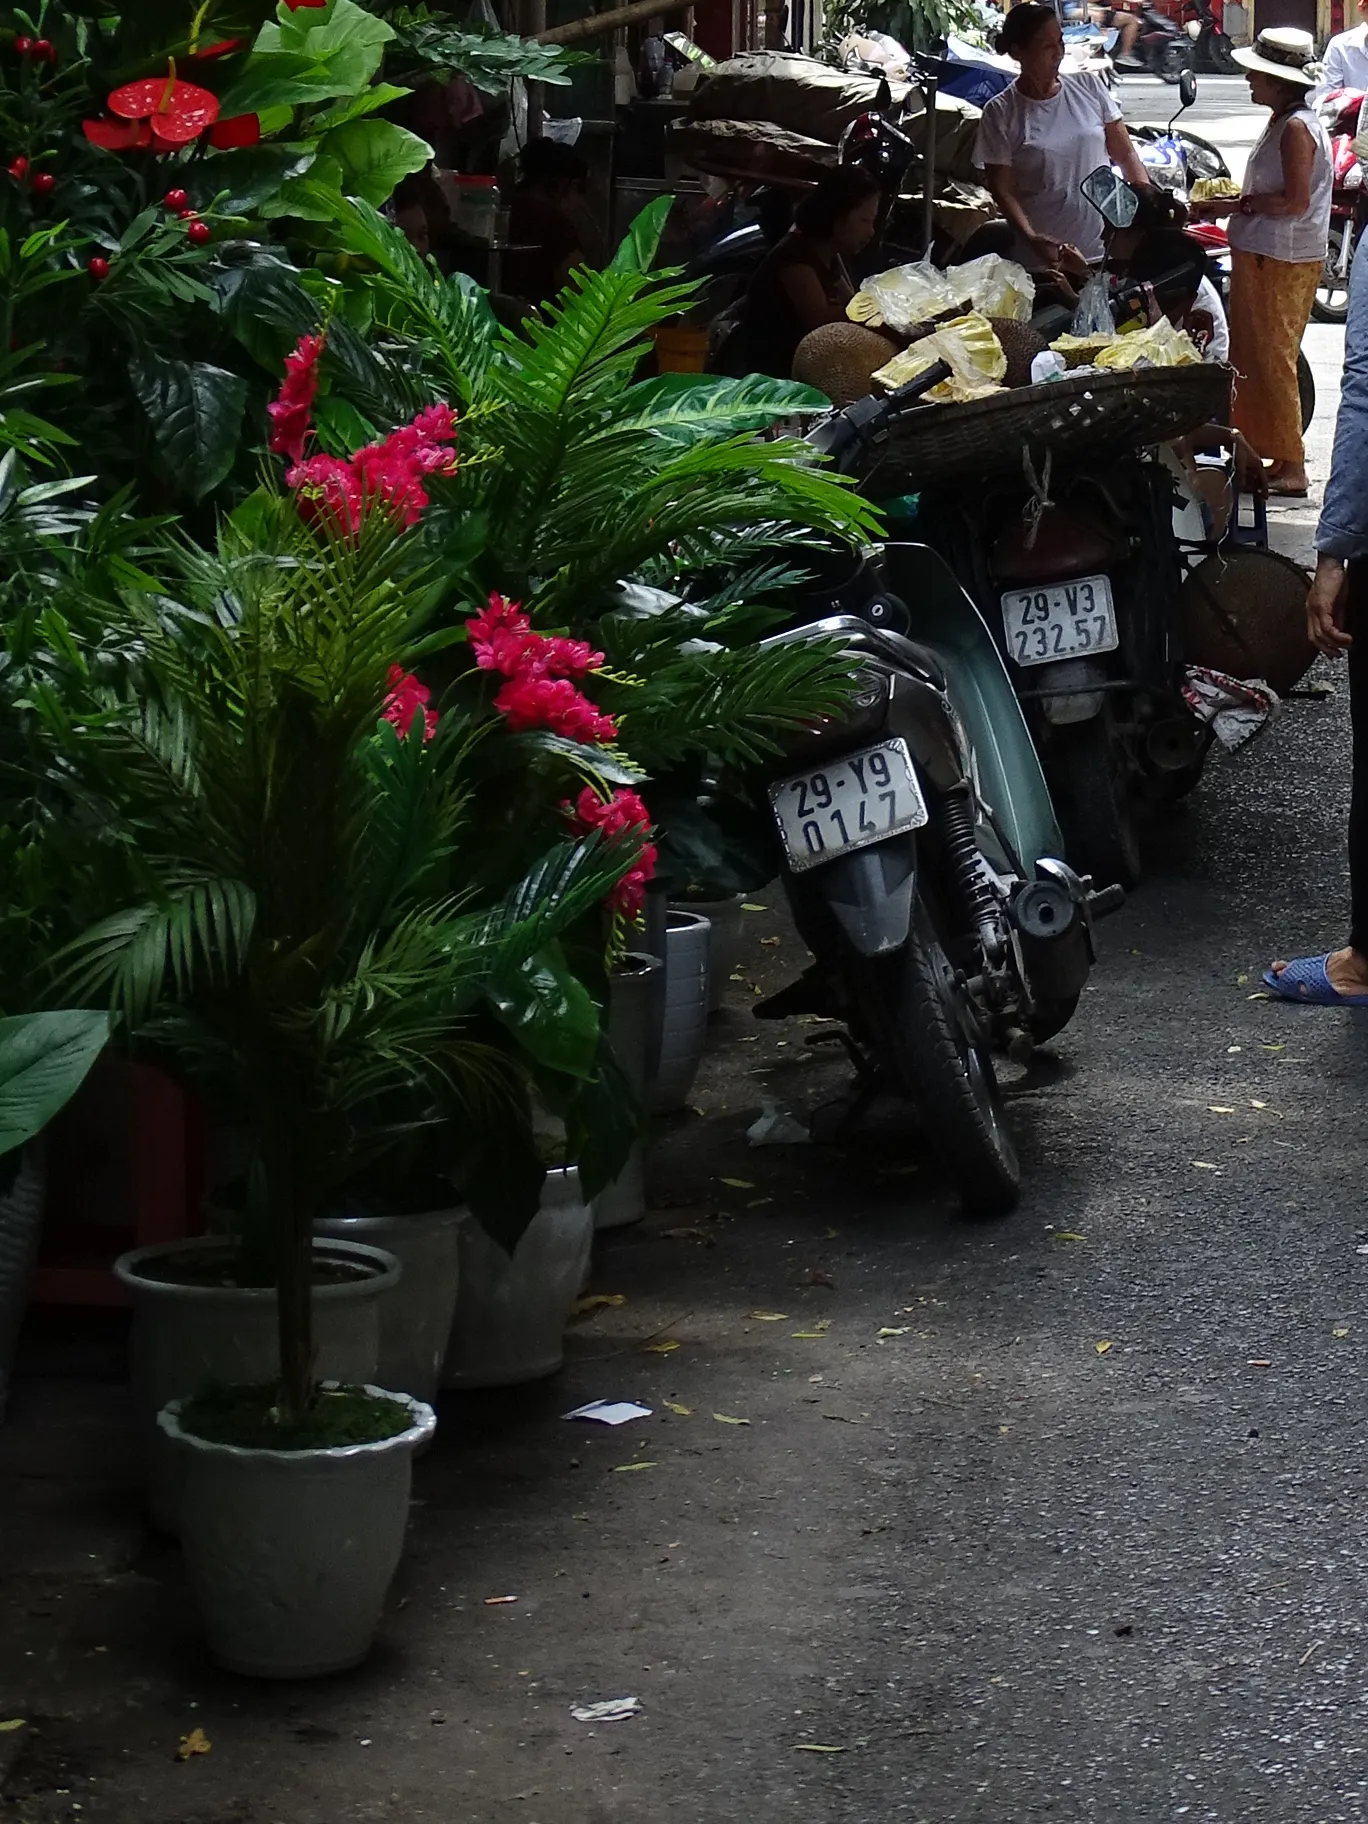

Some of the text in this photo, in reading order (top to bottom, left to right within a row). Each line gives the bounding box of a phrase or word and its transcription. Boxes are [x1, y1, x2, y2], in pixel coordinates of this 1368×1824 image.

[1018, 583, 1096, 626] 29-V3
[1014, 614, 1106, 661] 232.57
[790, 752, 892, 818] 29-Y9
[802, 789, 896, 855] 0147
